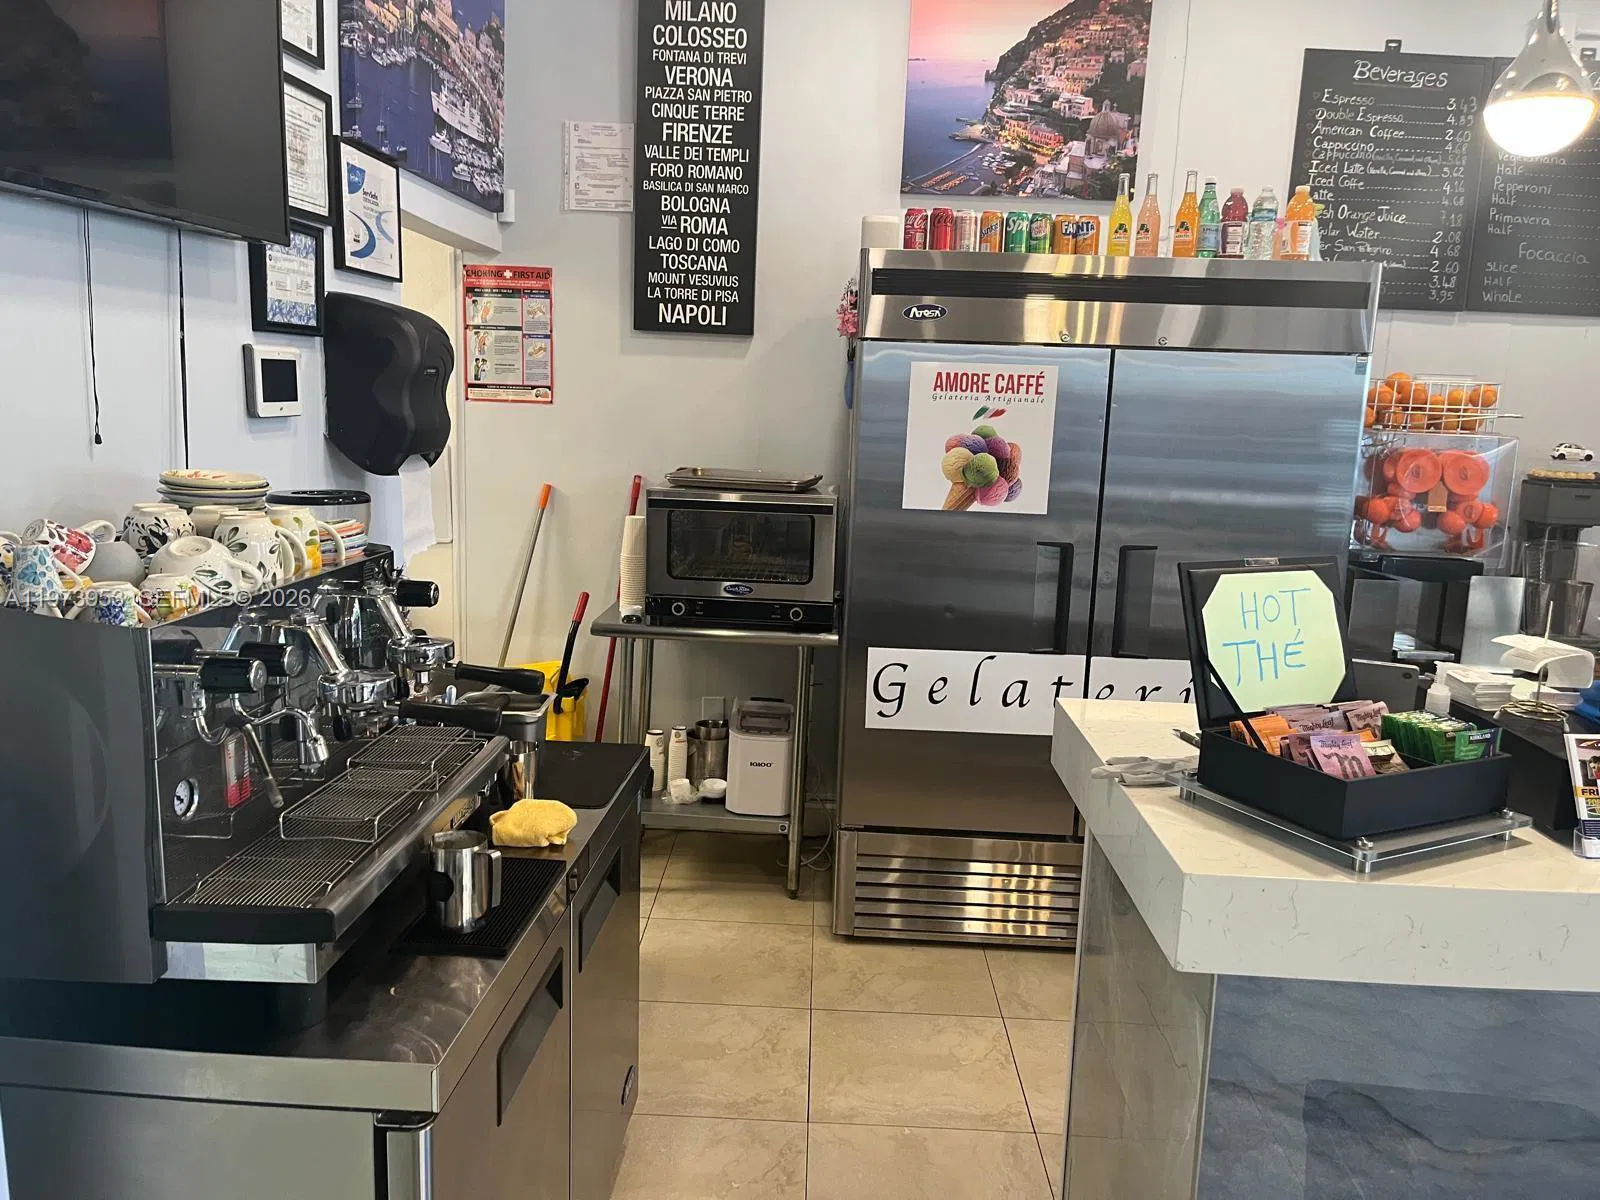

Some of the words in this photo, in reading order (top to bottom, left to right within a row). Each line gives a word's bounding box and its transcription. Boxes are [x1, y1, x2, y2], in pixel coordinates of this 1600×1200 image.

[665, 0, 737, 23] MILANO
[653, 24, 748, 49] COLOSSEO
[652, 49, 700, 63] FONTANA
[703, 51, 714, 64] DI
[717, 52, 747, 65] TREVI
[664, 65, 734, 87] VERONA
[1353, 60, 1449, 88] Beverages
[644, 86, 684, 101] PIAZZA
[687, 88, 710, 102] SAN
[713, 89, 752, 104] PIETRO
[1321, 88, 1376, 106] Espresso
[651, 103, 699, 121] CINQUE
[703, 105, 745, 122] TERRE
[1314, 107, 1355, 121] Double
[1356, 106, 1404, 124] Espresso
[662, 122, 733, 145] FIRENZE
[1311, 119, 1363, 136] American
[1369, 124, 1406, 141] Coffee
[1313, 135, 1375, 153] Cappuccino
[644, 145, 680, 160] VALLE
[683, 146, 702, 161] DEI
[706, 147, 749, 163] TEMPLI
[1311, 147, 1373, 161] Cappuccino
[650, 163, 683, 178] FORO
[687, 165, 743, 181] ROMANO
[1308, 160, 1339, 174] Iced
[1497, 163, 1525, 176] Half
[643, 180, 683, 193] BASILICA
[684, 181, 694, 192] DI
[695, 182, 715, 194] SAN
[716, 182, 749, 195] MARCO
[1306, 173, 1334, 187] Iced
[1494, 176, 1553, 196] Pepperoni
[1312, 189, 1335, 201] atte
[1490, 192, 1517, 206] Half
[661, 195, 731, 214] BOLOGNA
[1337, 204, 1376, 224] Orange
[1377, 206, 1407, 224] Juice
[1489, 207, 1552, 226] Primavera
[661, 215, 678, 228] VIA
[680, 216, 728, 235] ROMA
[1346, 222, 1381, 240] Water
[1487, 224, 1513, 236] Half
[648, 235, 683, 251] LAGO
[686, 237, 699, 251] DI
[702, 238, 740, 253] COMO
[1334, 239, 1356, 252] San
[1518, 241, 1590, 265] Focaccia
[660, 253, 728, 272] TOSCANA
[465, 269, 503, 278] CHOKING
[513, 270, 535, 279] FIRST
[535, 271, 550, 280] AID
[648, 272, 686, 286] MOUNT
[688, 273, 739, 288] VESUVIUS
[647, 286, 661, 299] LA
[664, 287, 698, 301] TORRE
[701, 289, 712, 301] DI
[714, 289, 739, 303] PISA
[658, 303, 727, 326] NAPOLI
[932, 371, 990, 393] AMORE
[994, 371, 1046, 395] CAFFÉ
[932, 393, 979, 401] Gelateria
[985, 395, 1045, 405] Artigianale
[1240, 588, 1311, 631] HOT
[1222, 629, 1307, 687] THÉ
